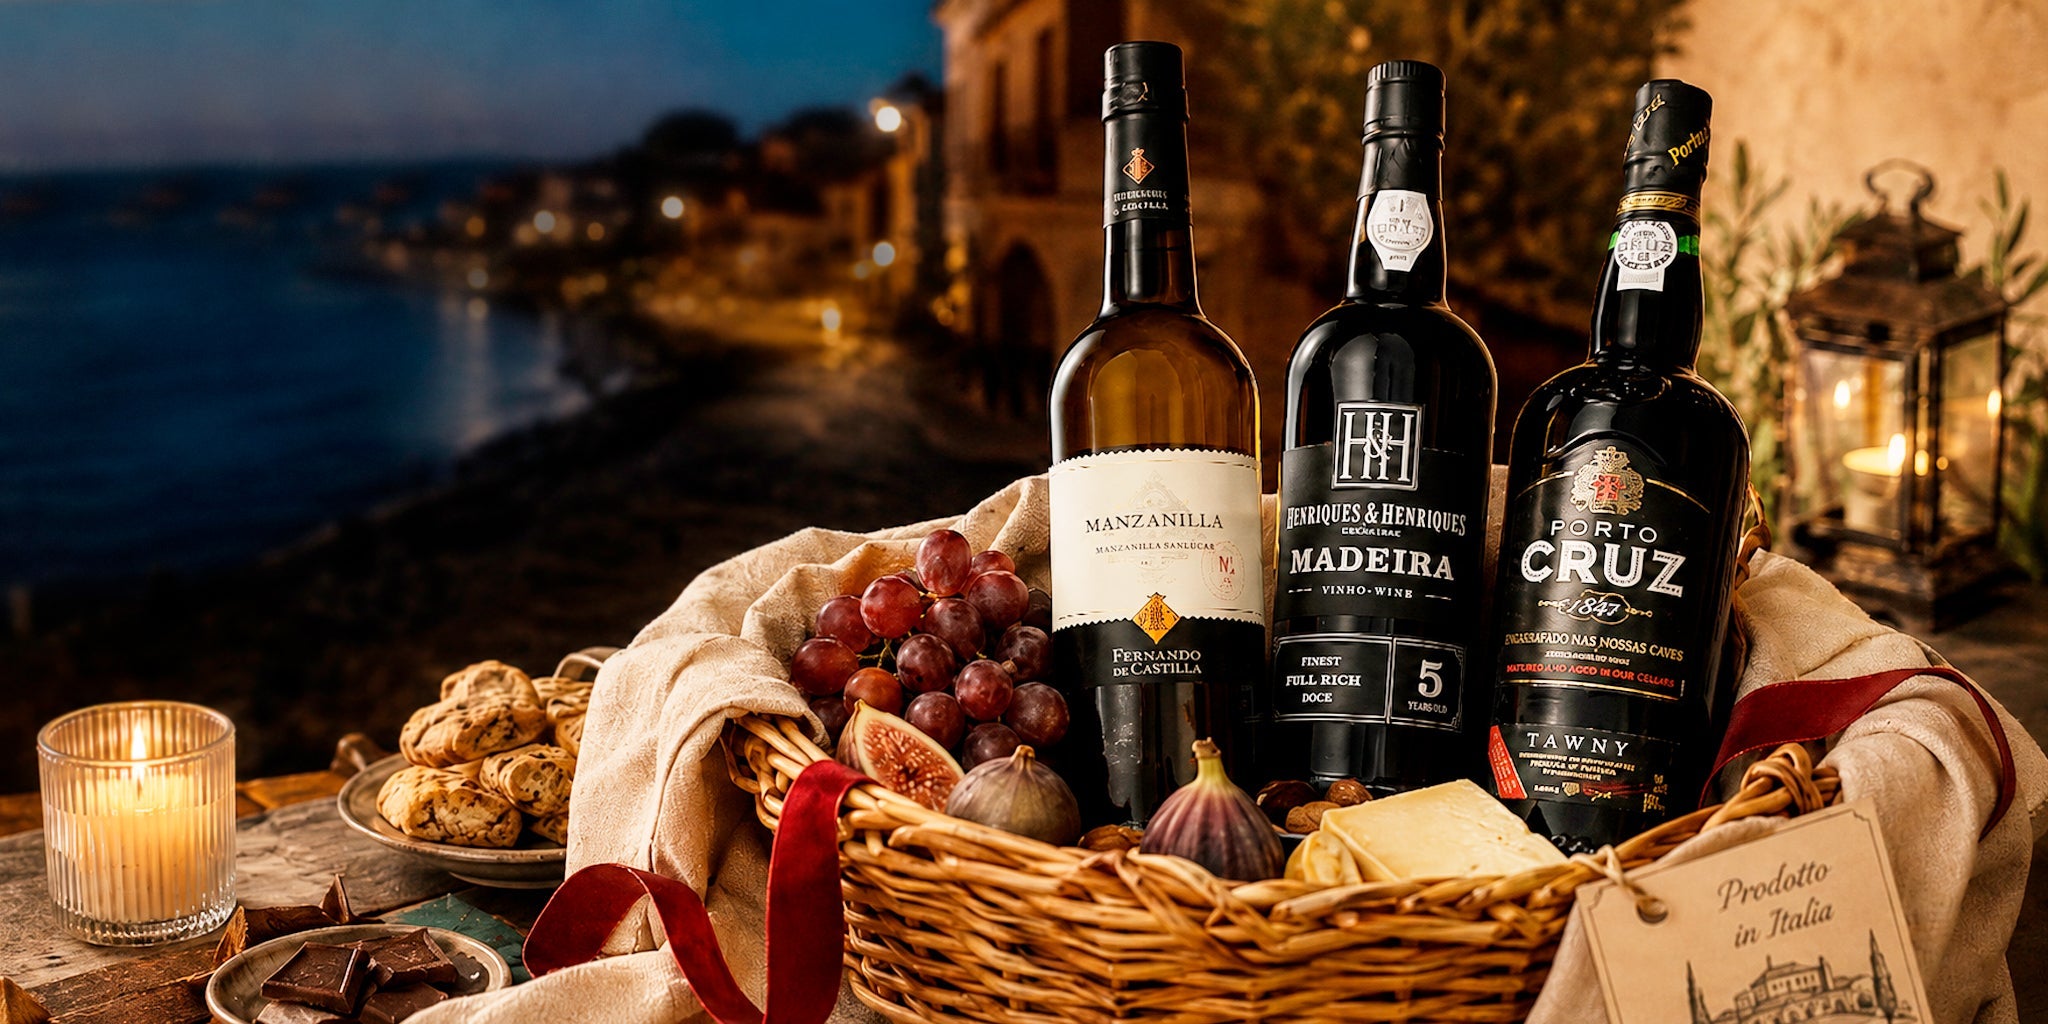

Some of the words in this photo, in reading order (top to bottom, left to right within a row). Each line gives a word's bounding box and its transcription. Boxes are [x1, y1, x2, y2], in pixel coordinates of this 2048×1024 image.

[1085, 513, 1224, 533] MANZANILLA
[1286, 504, 1361, 530] HENRIQUES
[1364, 502, 1380, 524] &
[1382, 503, 1467, 536] HENRIQUES
[1550, 519, 1658, 543] PORTO
[1095, 542, 1161, 555] MANZANILLA
[1289, 546, 1454, 581] MADEIRA
[1520, 539, 1687, 598] CRUZ
[1568, 597, 1621, 617] 1847
[1112, 648, 1201, 663] FERNANDO
[1571, 633, 1597, 647] NAS
[1600, 636, 1647, 654] NOSSAS
[1649, 644, 1684, 661] CAVES
[1113, 667, 1129, 677] DE
[1130, 662, 1202, 676] CASTILLA
[1301, 656, 1342, 667] FINEST
[1285, 675, 1317, 687] FULL
[1320, 674, 1361, 687] RICH
[1418, 659, 1443, 698] 5
[1612, 669, 1635, 680] OUR
[1302, 692, 1332, 703] DOCE
[1527, 732, 1629, 757] TAWNY
[1717, 861, 1832, 914] Prodotto
[1734, 924, 1759, 948] in
[1766, 897, 1834, 940] Italia
